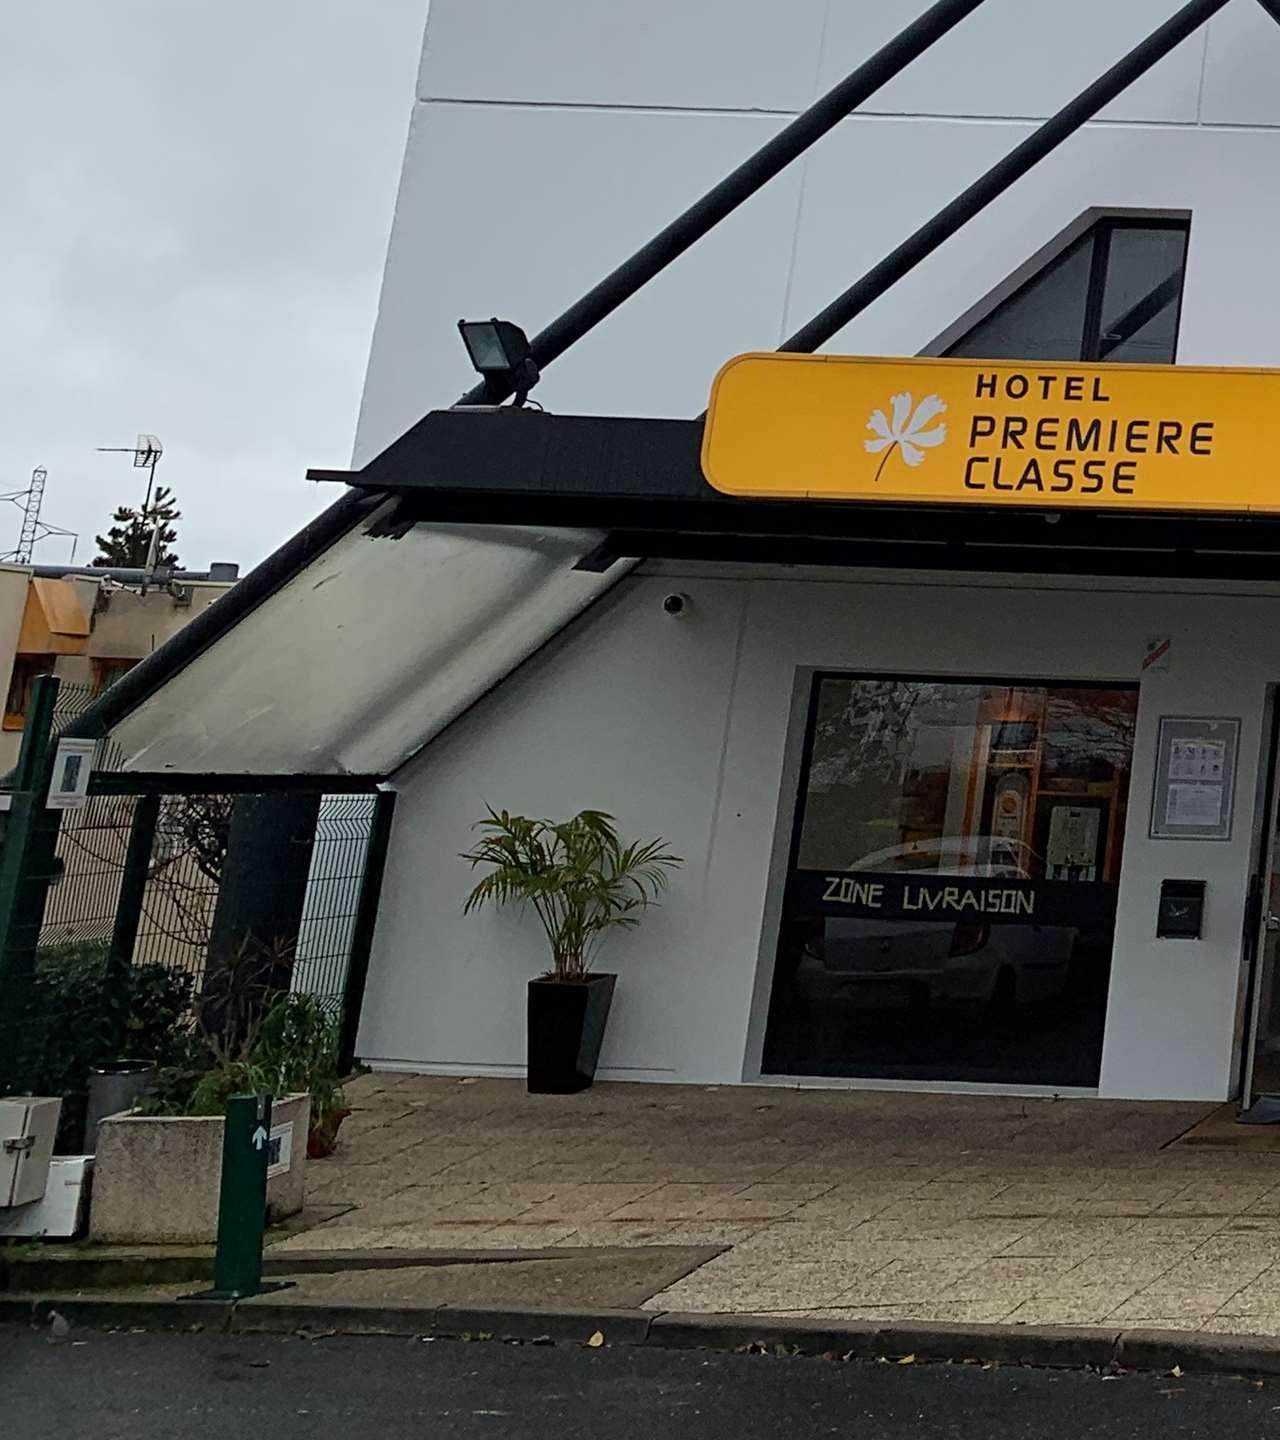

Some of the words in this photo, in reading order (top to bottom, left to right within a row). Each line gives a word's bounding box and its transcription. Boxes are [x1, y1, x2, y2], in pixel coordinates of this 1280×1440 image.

[975, 373, 1111, 403] HOTEL
[968, 415, 1214, 456] PREMIERE
[963, 456, 1138, 495] CLASSE
[821, 876, 884, 909] ZONE
[902, 885, 1036, 915] LIVRAISON
